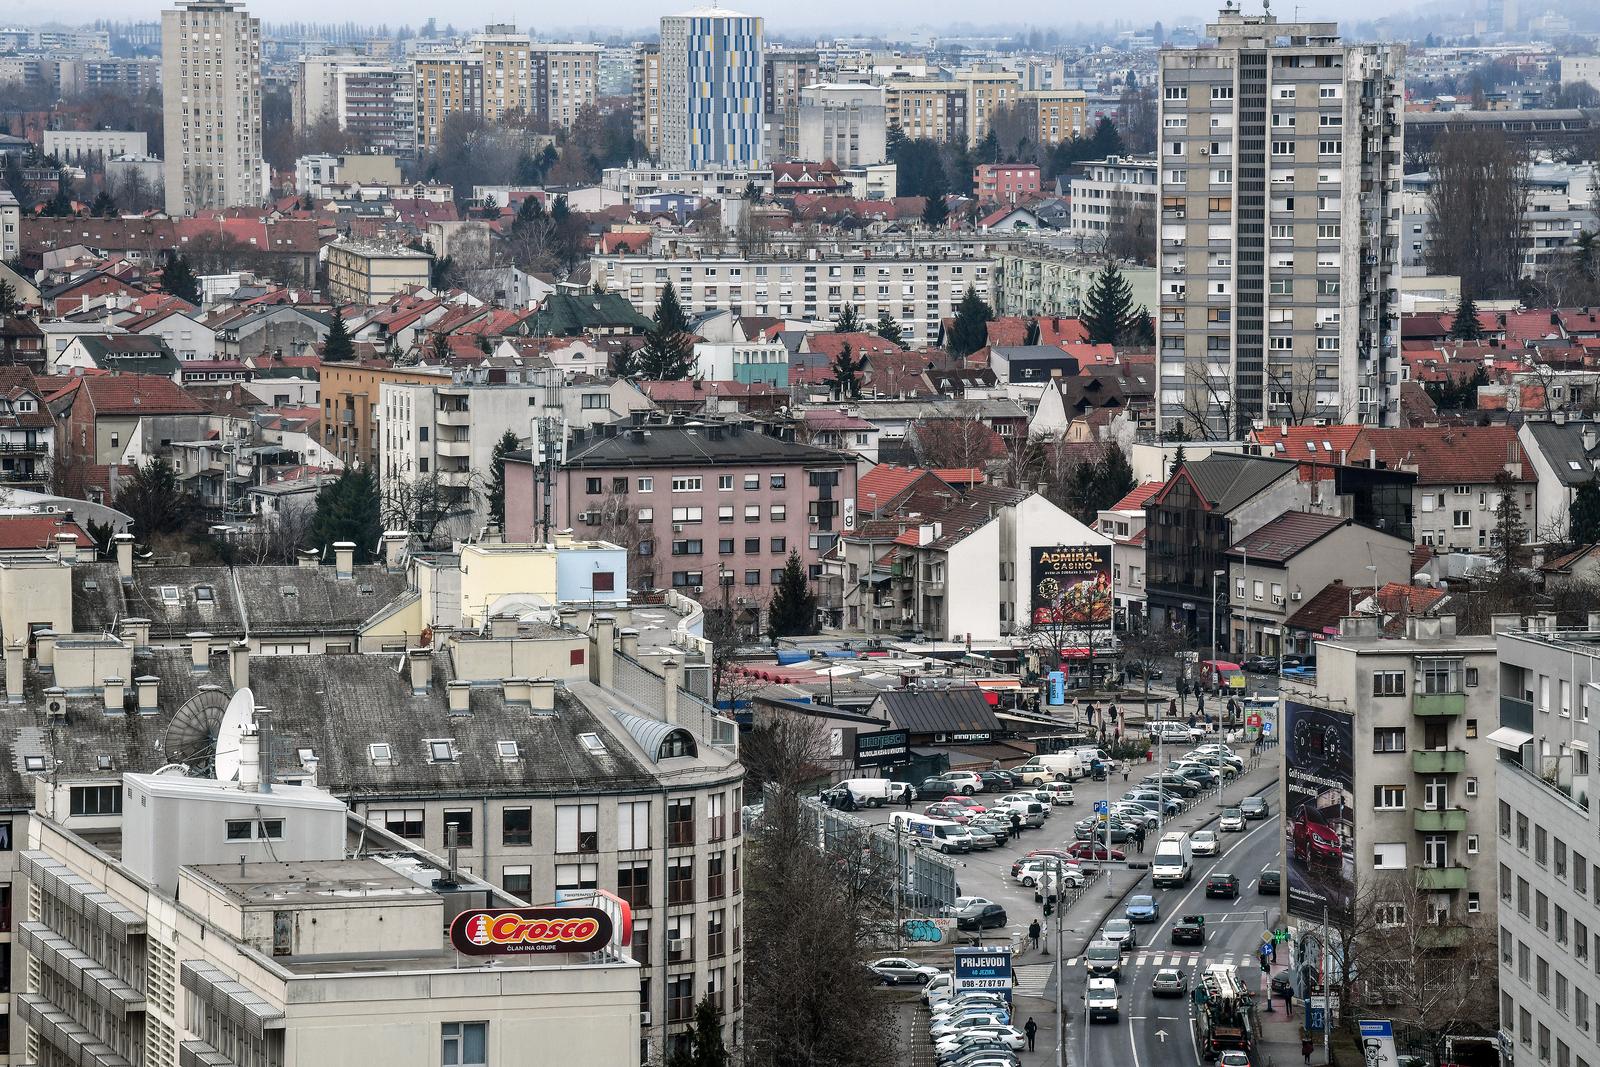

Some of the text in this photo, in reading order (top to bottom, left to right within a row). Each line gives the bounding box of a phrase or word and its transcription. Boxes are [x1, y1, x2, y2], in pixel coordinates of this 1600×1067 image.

[1040, 551, 1102, 563] ADMIRAL
[1053, 562, 1092, 570] CASINO
[1288, 768, 1297, 778] Golf
[491, 914, 598, 942] Crosco
[961, 957, 1005, 967] PRIJEVODI
